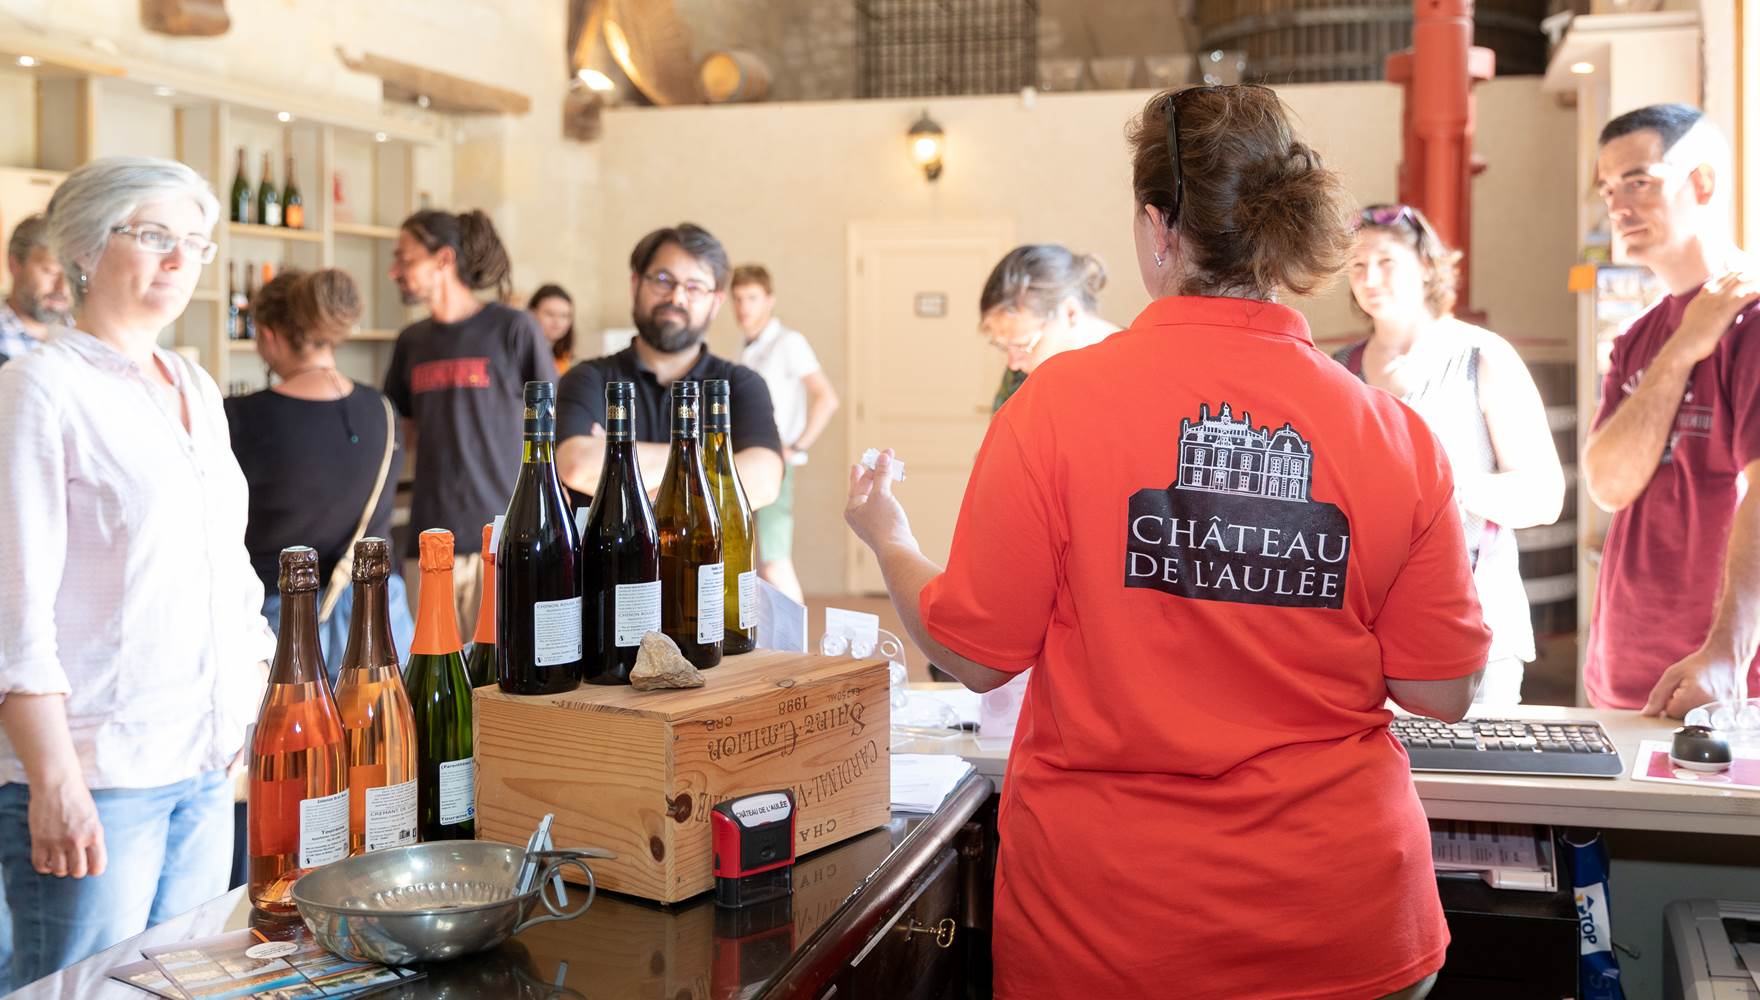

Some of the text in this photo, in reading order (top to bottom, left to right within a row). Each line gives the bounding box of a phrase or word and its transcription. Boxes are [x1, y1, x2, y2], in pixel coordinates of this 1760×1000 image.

[1132, 514, 1349, 563] CHÂTEAU
[1129, 551, 1339, 598] DE L'AULÉE
[778, 695, 809, 715] 1998
[759, 806, 766, 814] DE
